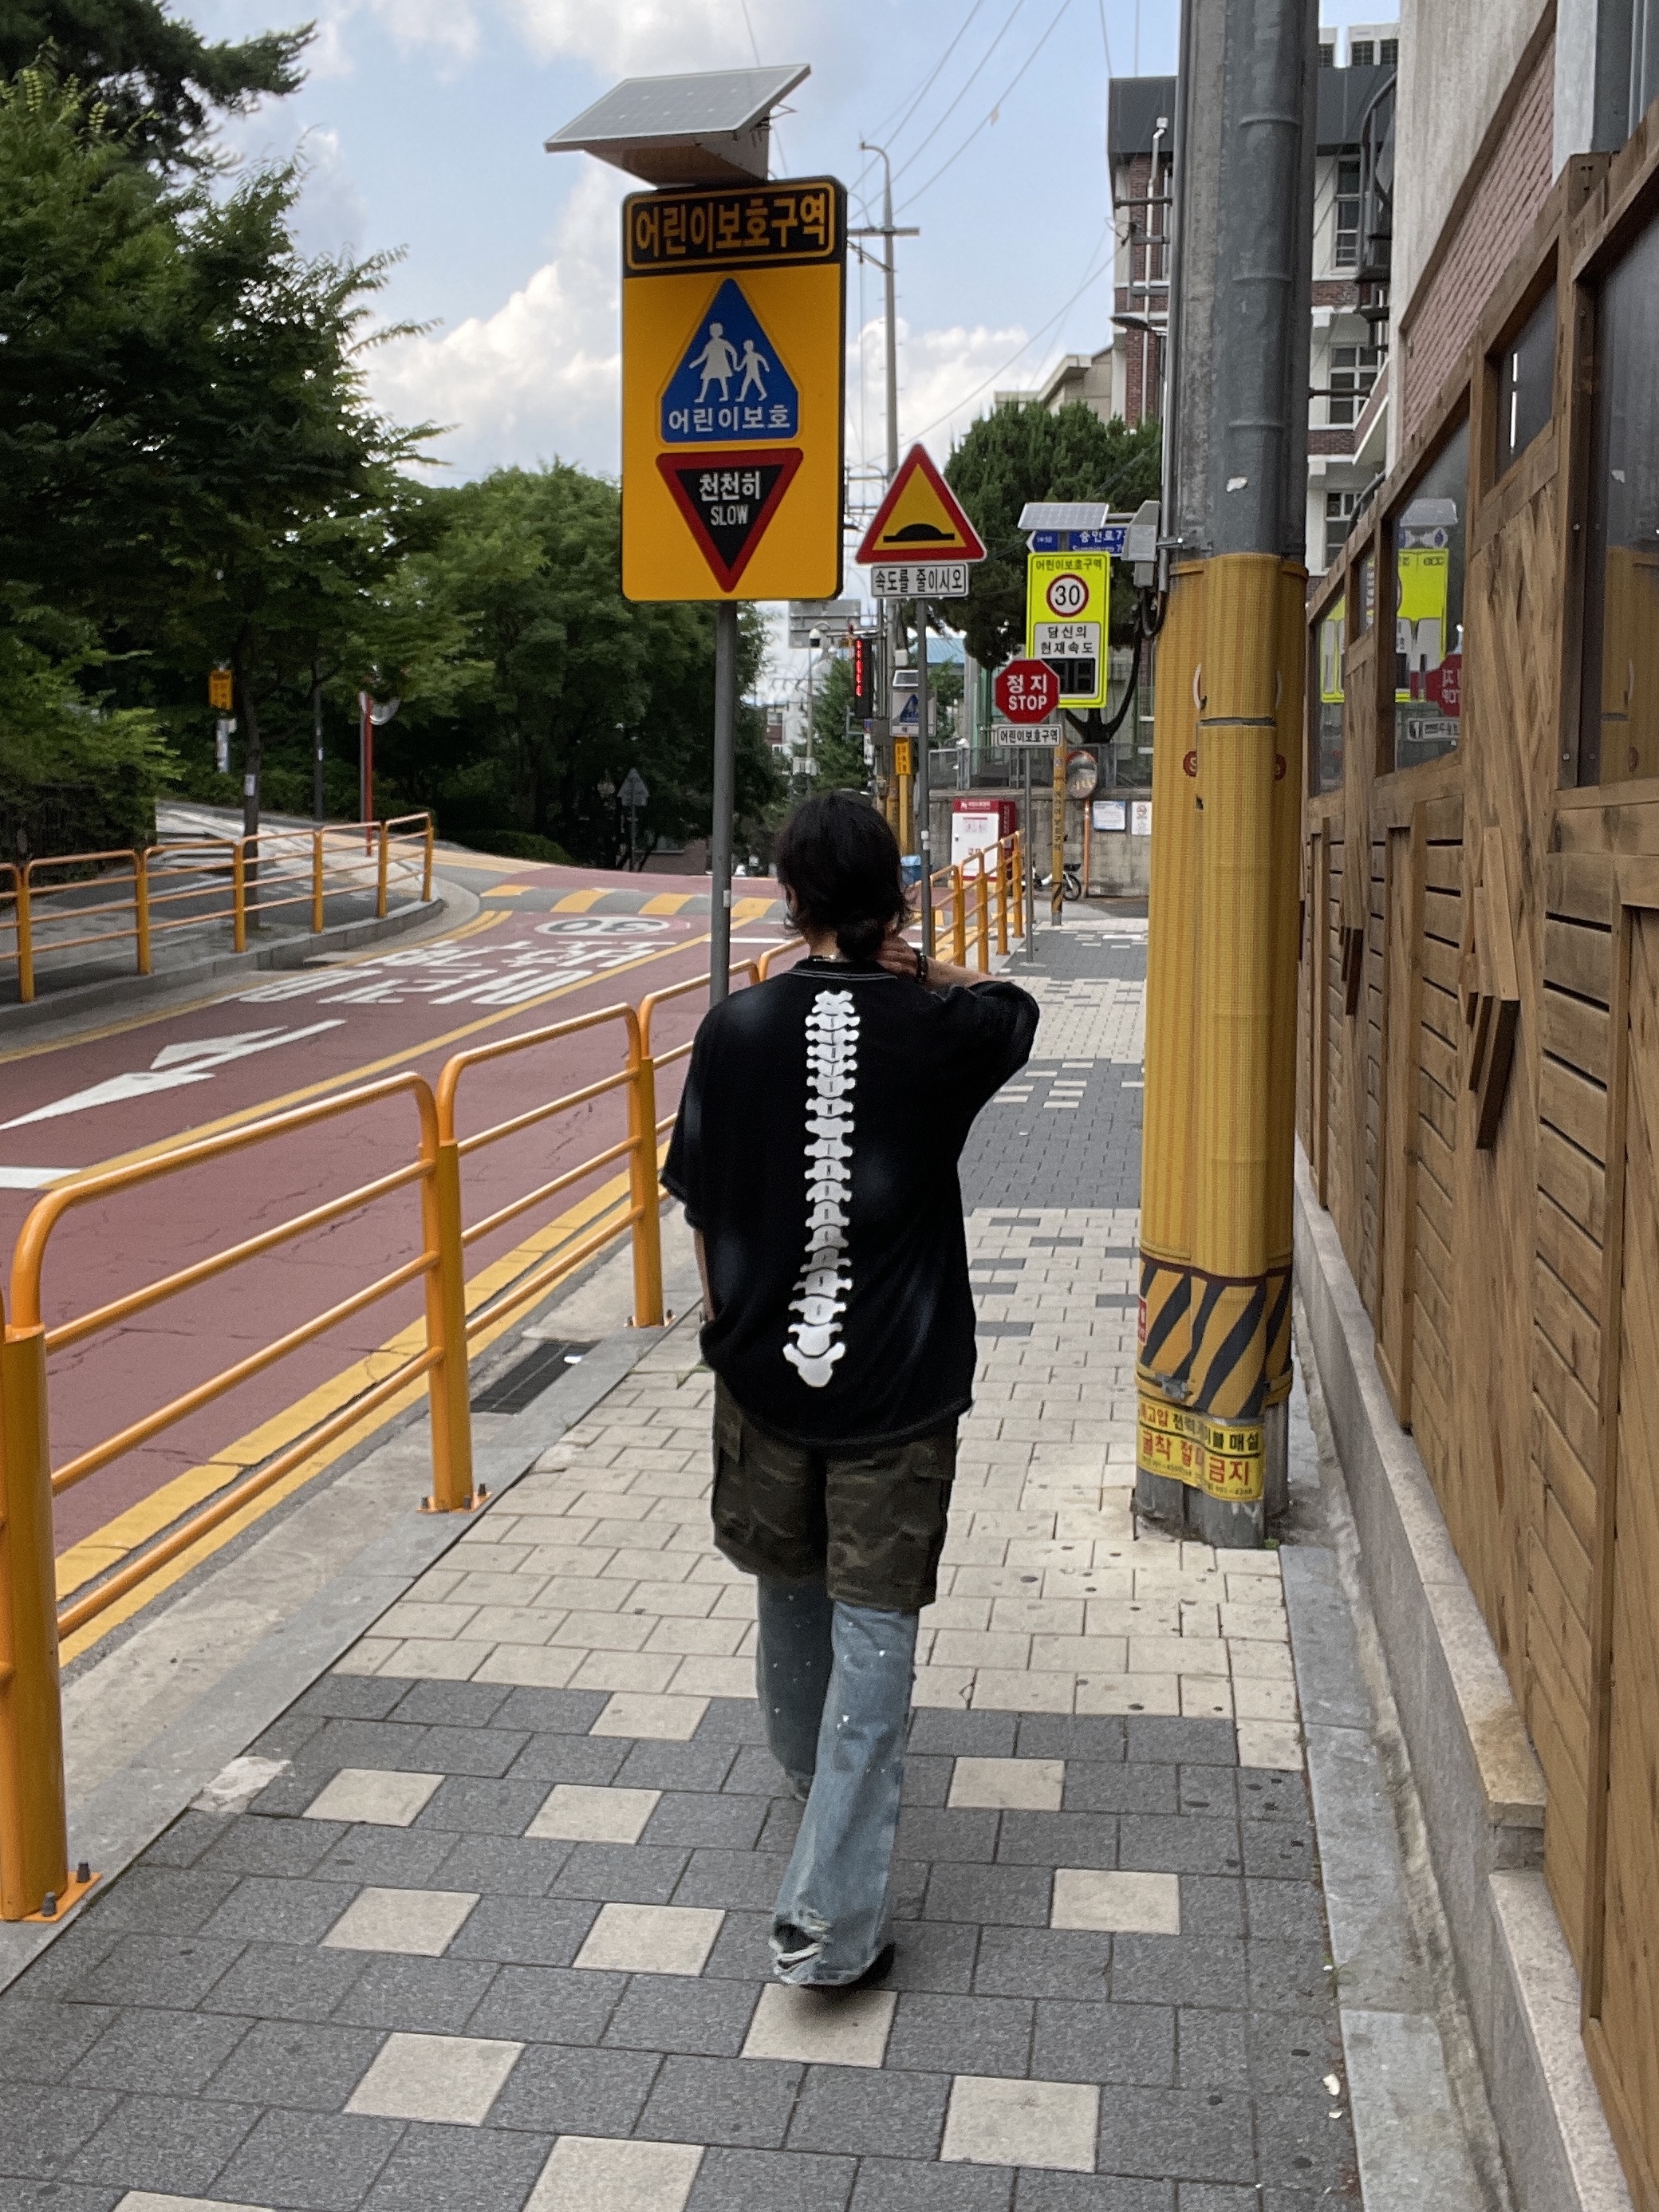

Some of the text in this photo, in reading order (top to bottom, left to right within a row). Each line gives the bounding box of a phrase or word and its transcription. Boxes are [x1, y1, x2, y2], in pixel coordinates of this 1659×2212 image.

[636, 193, 826, 257] 어린이보호구역
[668, 404, 790, 434] 어린이보호
[699, 471, 763, 501] 천천히
[710, 505, 748, 526] SLOW
[1035, 558, 1101, 571] 어린이보호구역
[875, 567, 963, 593] 속도를 줄이시오
[1054, 585, 1080, 606] 30
[1041, 642, 1094, 655] 현재속도
[1008, 695, 1047, 711] STOP
[1000, 729, 1058, 743] 어린이보호구역
[546, 919, 664, 934] 30
[353, 940, 677, 968] 보호구역
[211, 969, 593, 1005] 어린이
[1229, 1432, 1259, 1451] 매설
[1143, 1430, 1172, 1461] 굴착
[1209, 1457, 1251, 1485] 금지
